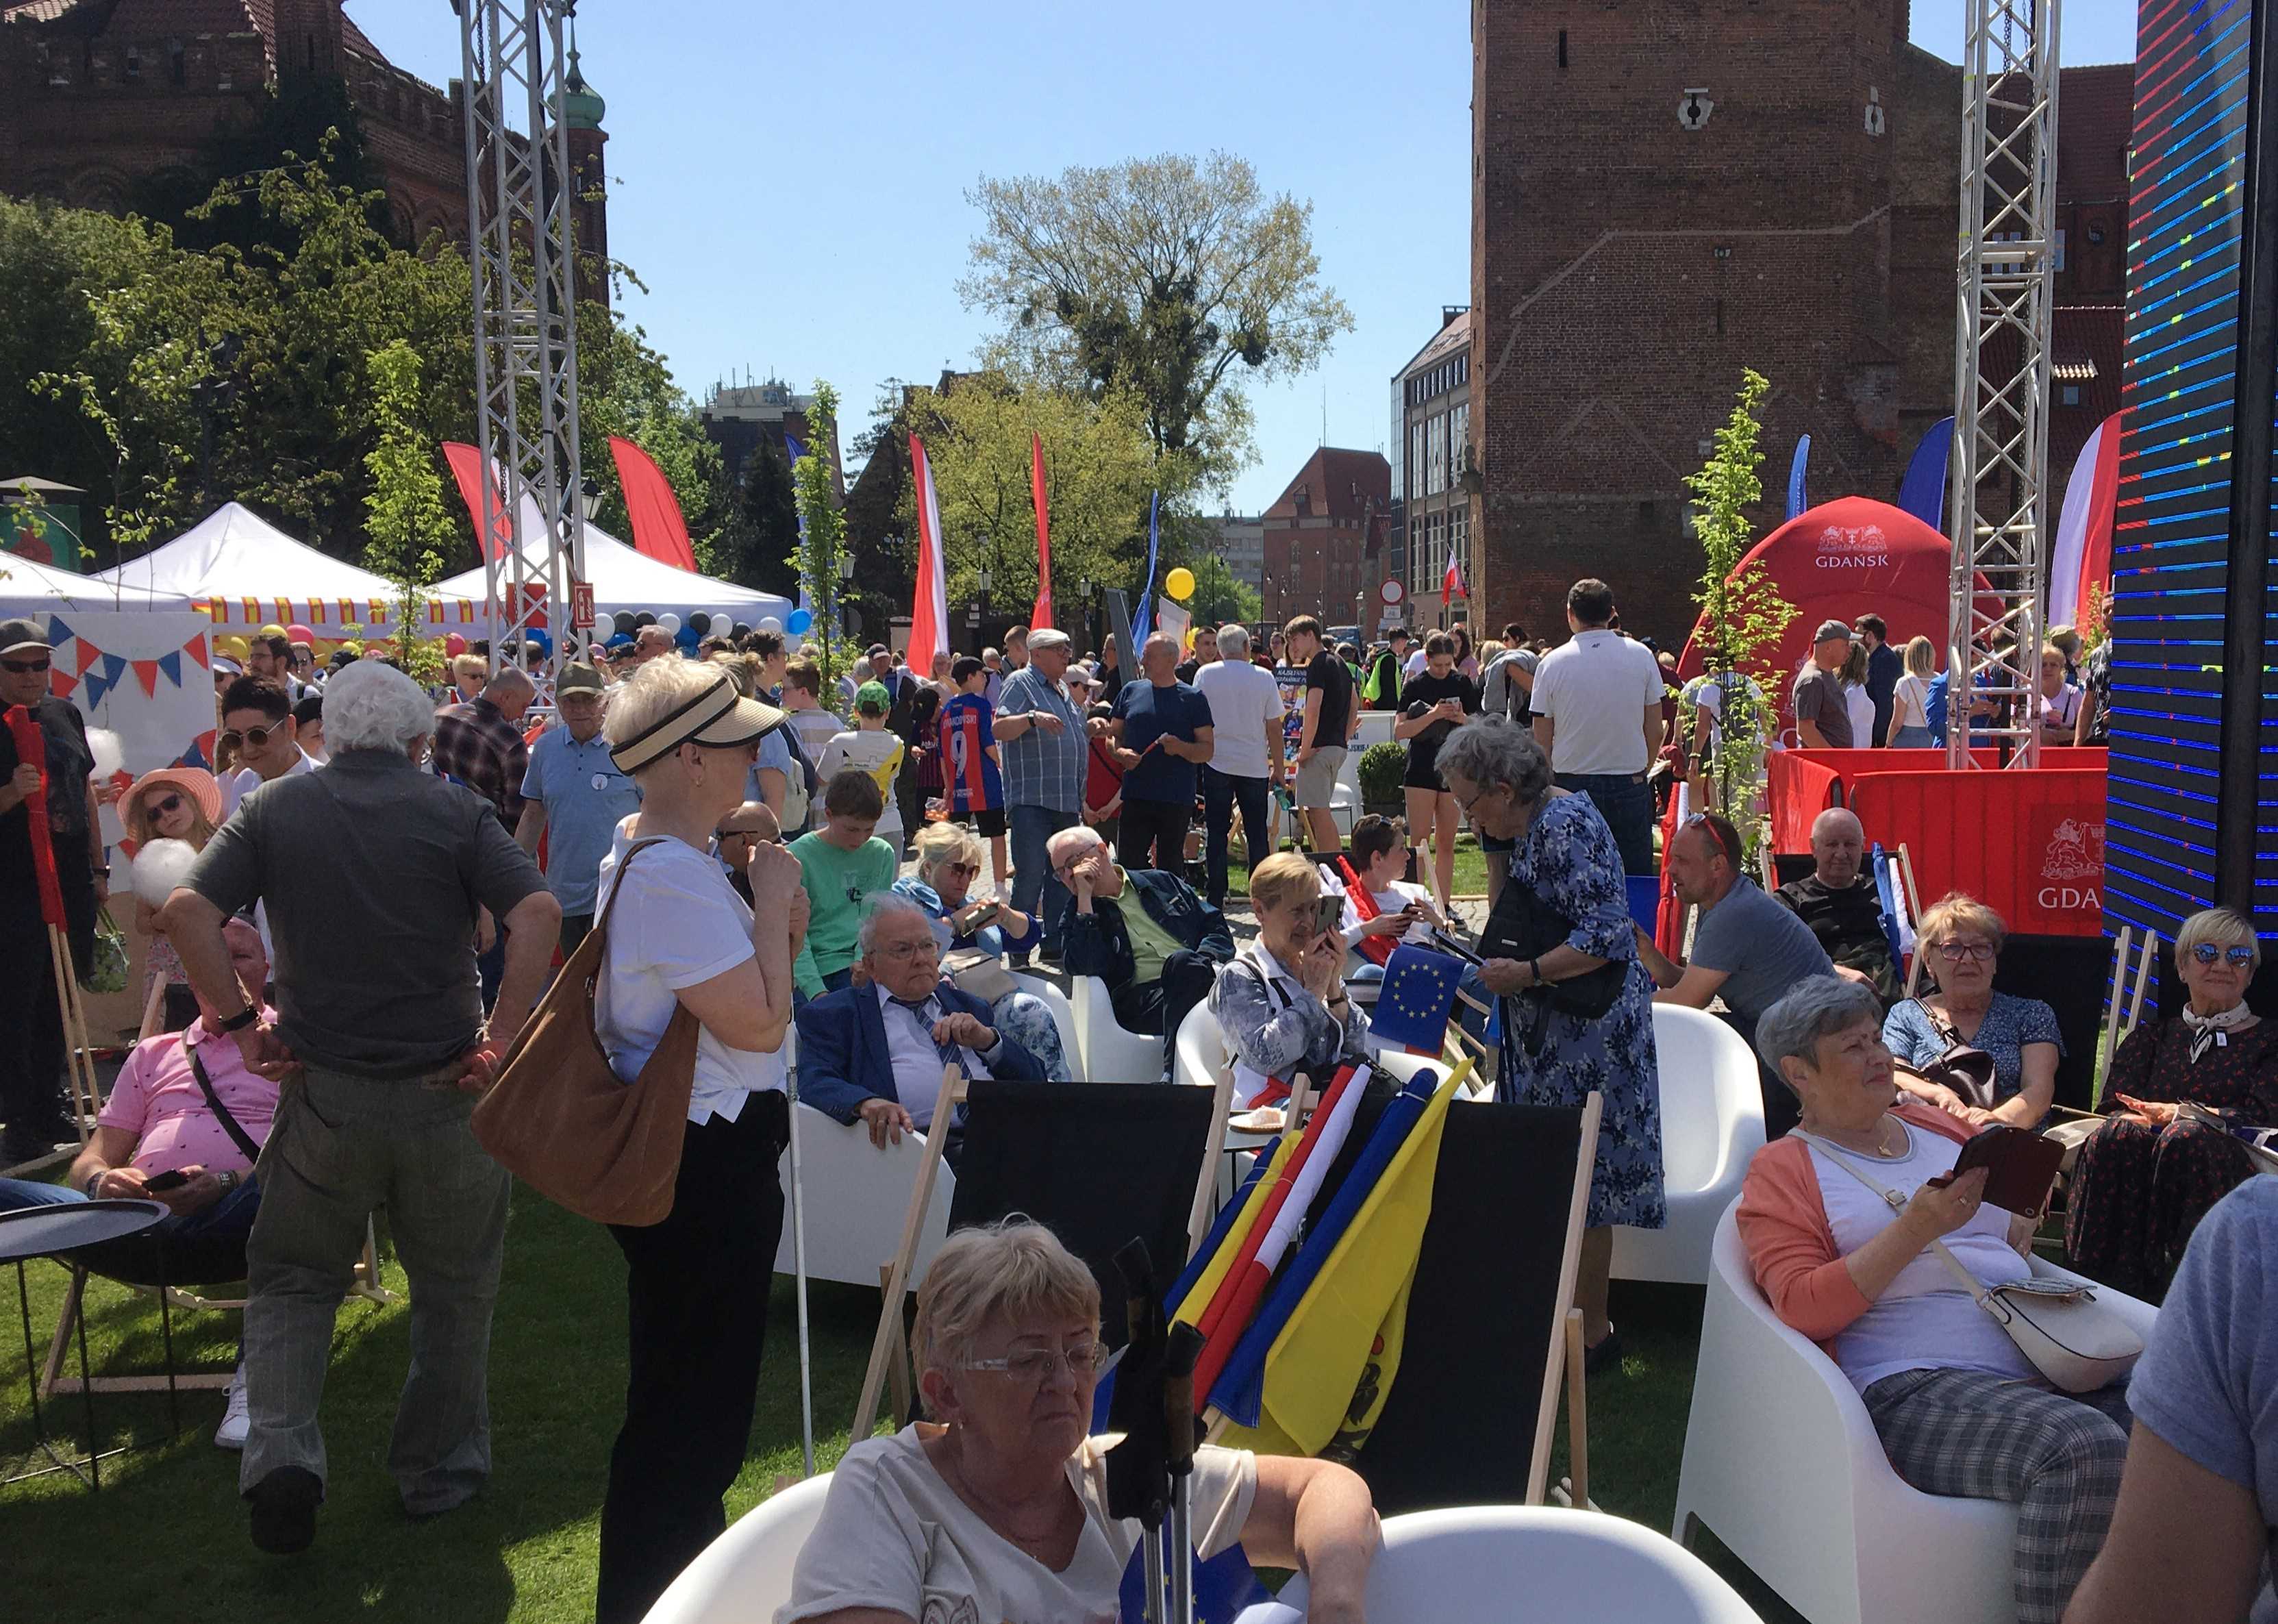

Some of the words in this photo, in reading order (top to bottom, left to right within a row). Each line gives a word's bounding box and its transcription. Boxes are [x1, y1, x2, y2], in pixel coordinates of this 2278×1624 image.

[1815, 553, 1889, 568] GDAŃSK
[950, 731, 967, 778] 9
[2038, 887, 2101, 909] GDA
